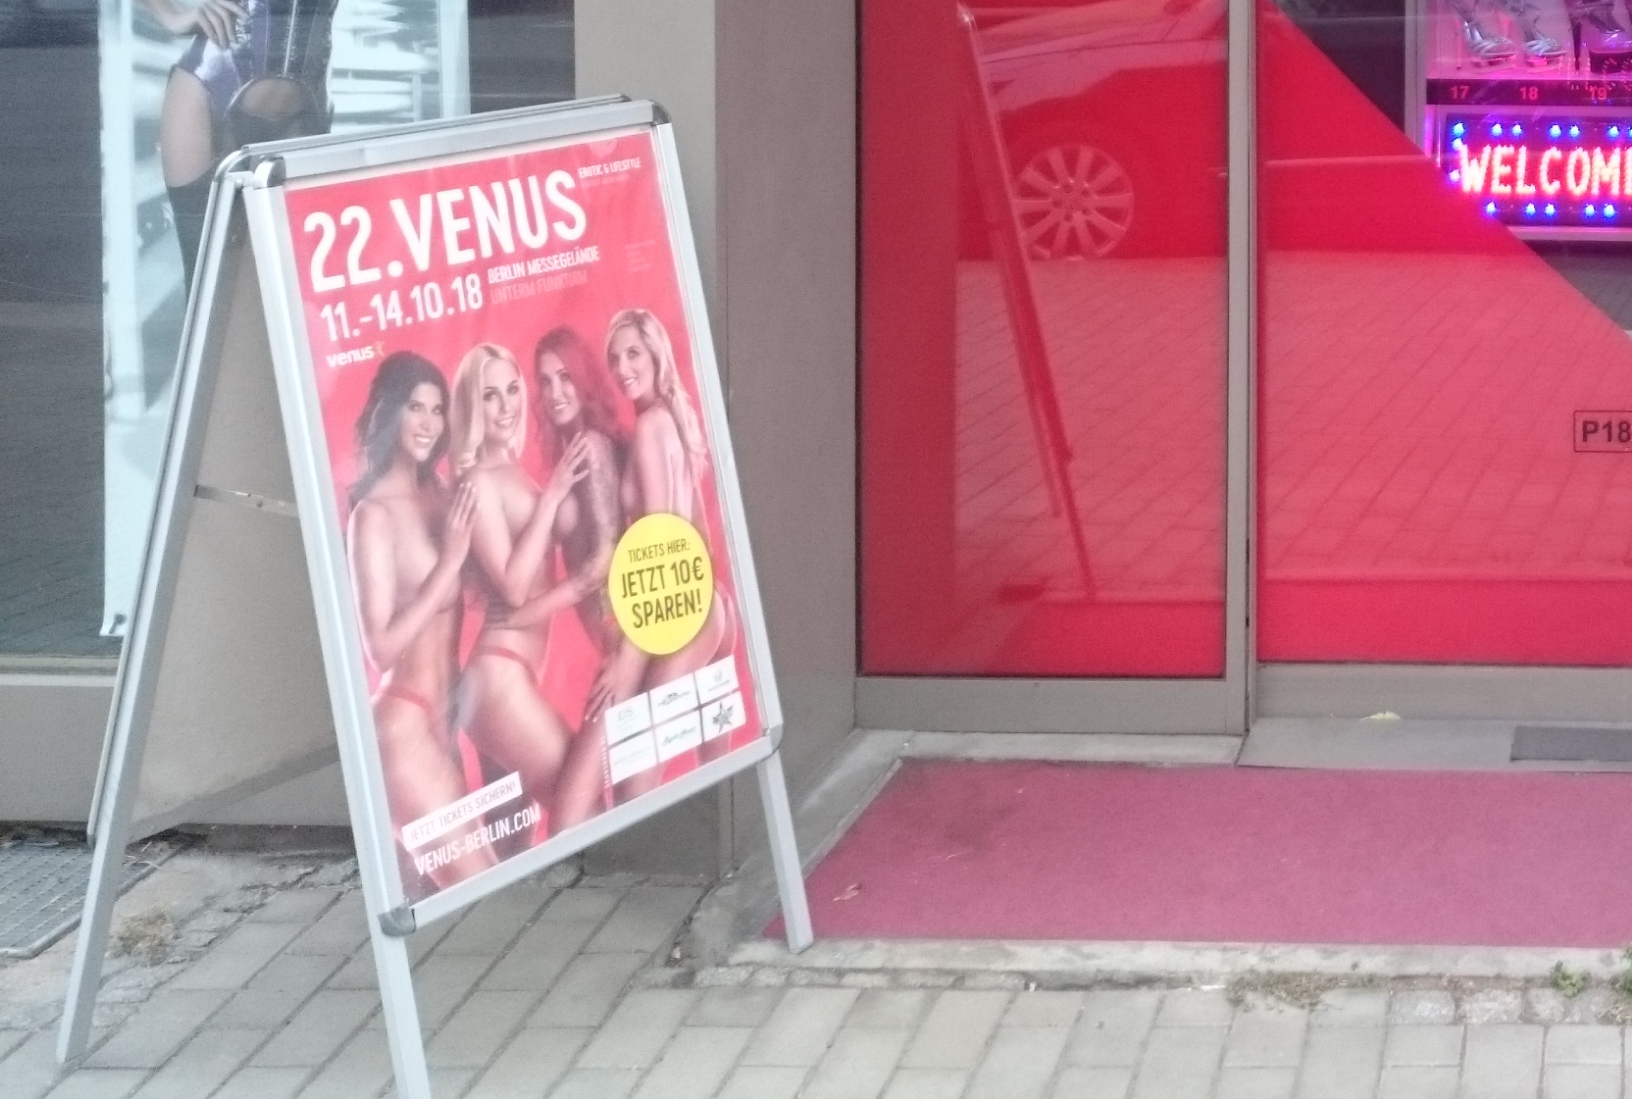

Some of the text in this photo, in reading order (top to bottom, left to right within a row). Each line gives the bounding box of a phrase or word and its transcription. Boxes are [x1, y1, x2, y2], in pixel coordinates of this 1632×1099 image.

[1450, 85, 1470, 99] 17
[1519, 86, 1538, 100] 18
[1589, 87, 1607, 100] 19
[488, 261, 525, 284] BERLIN
[527, 246, 600, 275] MESSEGELÄNDE
[320, 273, 483, 342] 11.-14.10.18
[326, 344, 375, 368] venus
[1581, 419, 1632, 445] P18
[628, 538, 691, 562] TICKETS HIER:
[622, 556, 705, 599] JETZT 10€
[632, 588, 703, 629] SPAREN!
[410, 781, 515, 841] JETZT TICKETS SICHERN!
[414, 802, 541, 876] VENUS-BERLIN.COM
